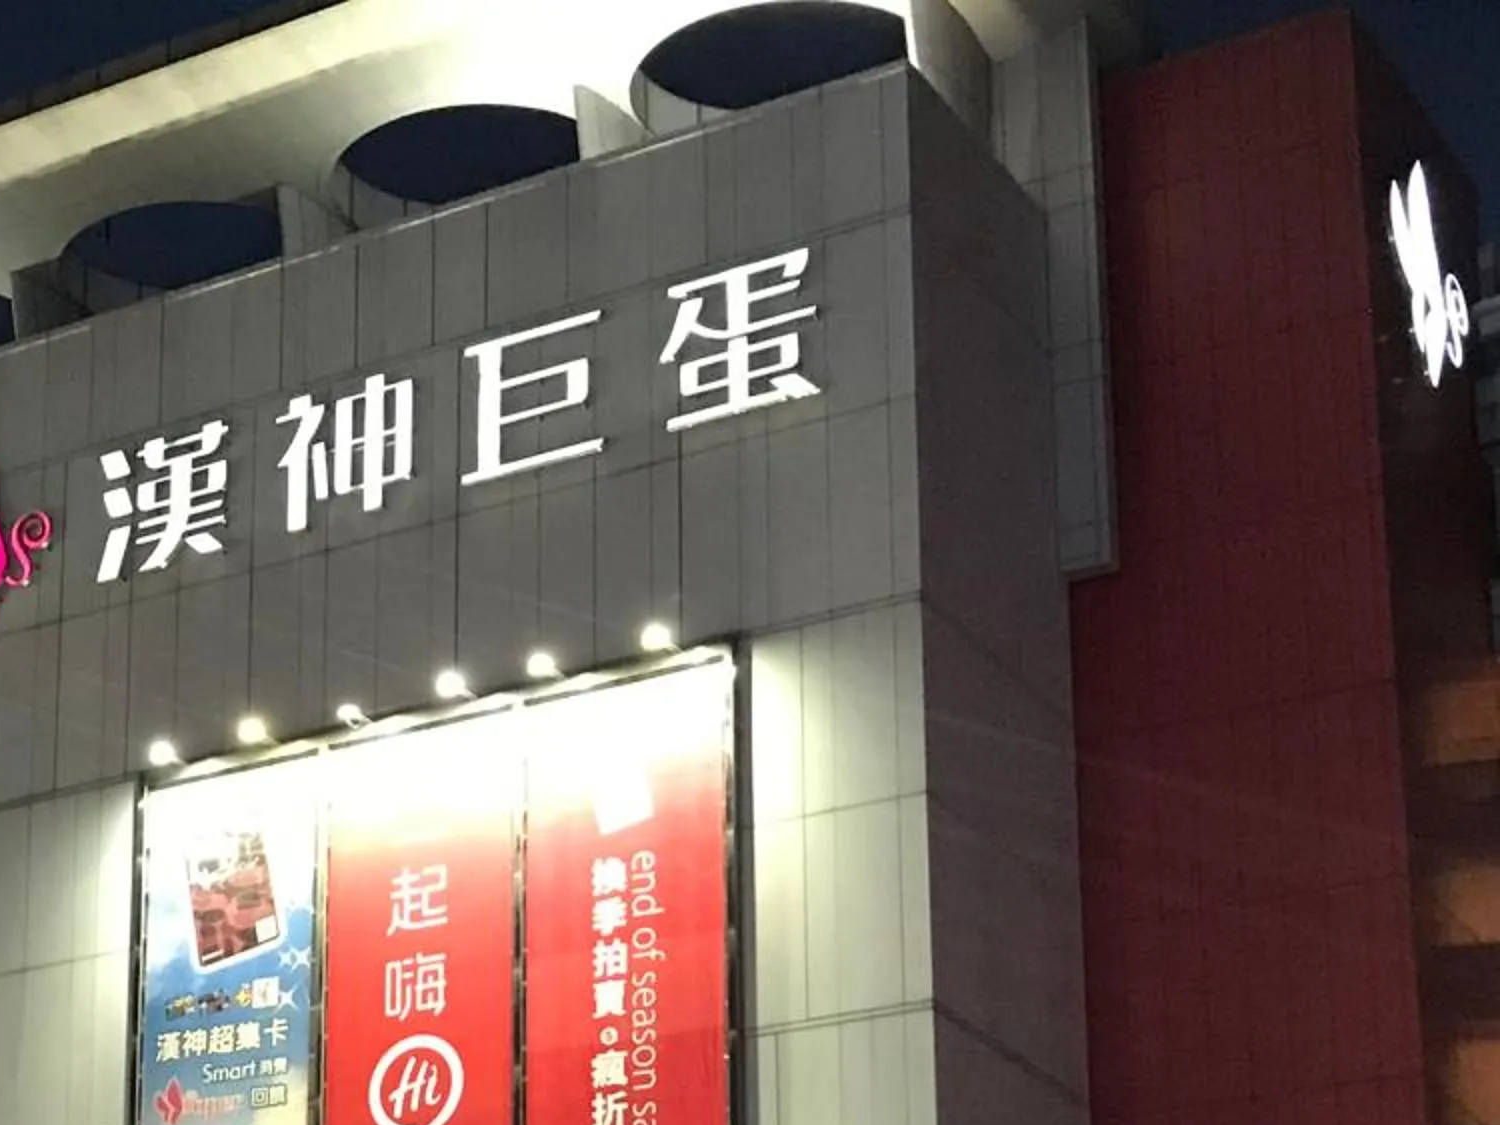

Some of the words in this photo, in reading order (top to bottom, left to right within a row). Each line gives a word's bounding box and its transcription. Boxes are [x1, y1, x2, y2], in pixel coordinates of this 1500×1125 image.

[96, 247, 822, 585] 漢神巨蛋
[631, 849, 665, 917] end
[384, 863, 449, 1022] 起嗨
[631, 927, 666, 962] of
[202, 1060, 257, 1084] Smart
[631, 971, 658, 1091] season
